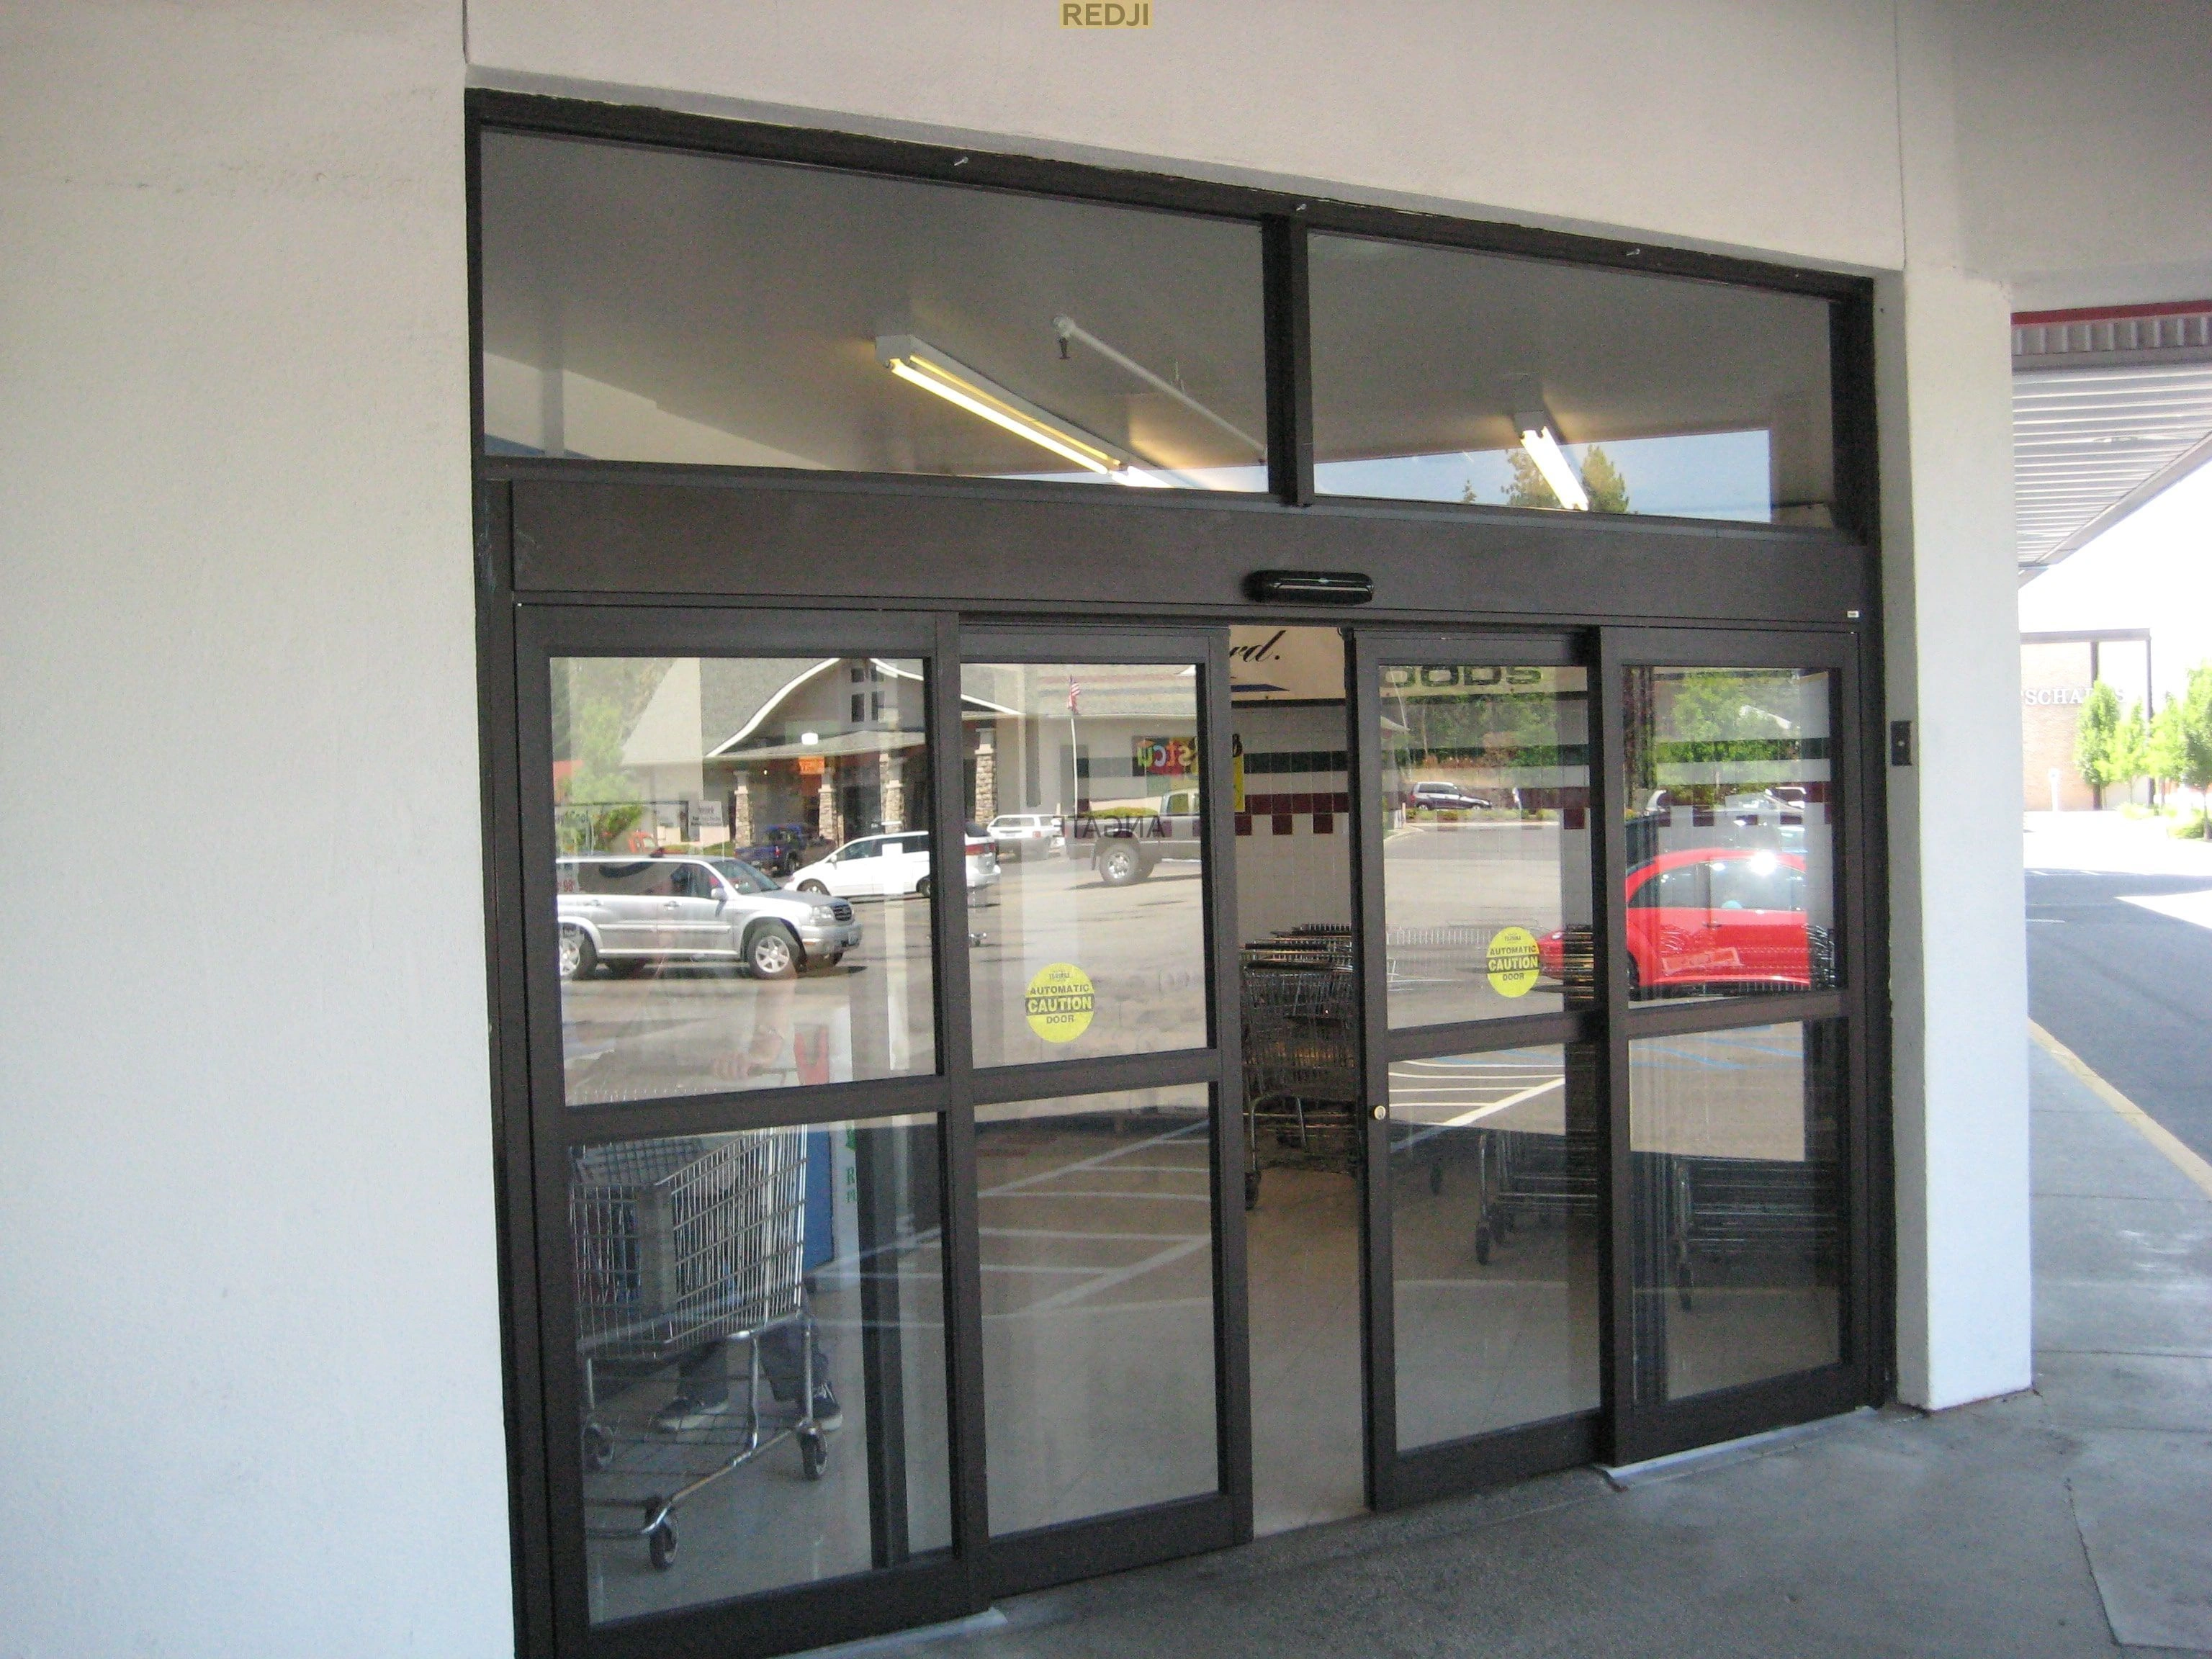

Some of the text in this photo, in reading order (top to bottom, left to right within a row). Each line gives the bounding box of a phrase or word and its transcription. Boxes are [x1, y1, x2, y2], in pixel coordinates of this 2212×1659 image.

[1490, 945, 1537, 955] AUTOMATIC
[1488, 956, 1538, 971] CAUTION
[1030, 984, 1089, 995] AUTOMATIC
[1028, 996, 1092, 1013] CAUTION
[1046, 1015, 1074, 1024] DOOR
